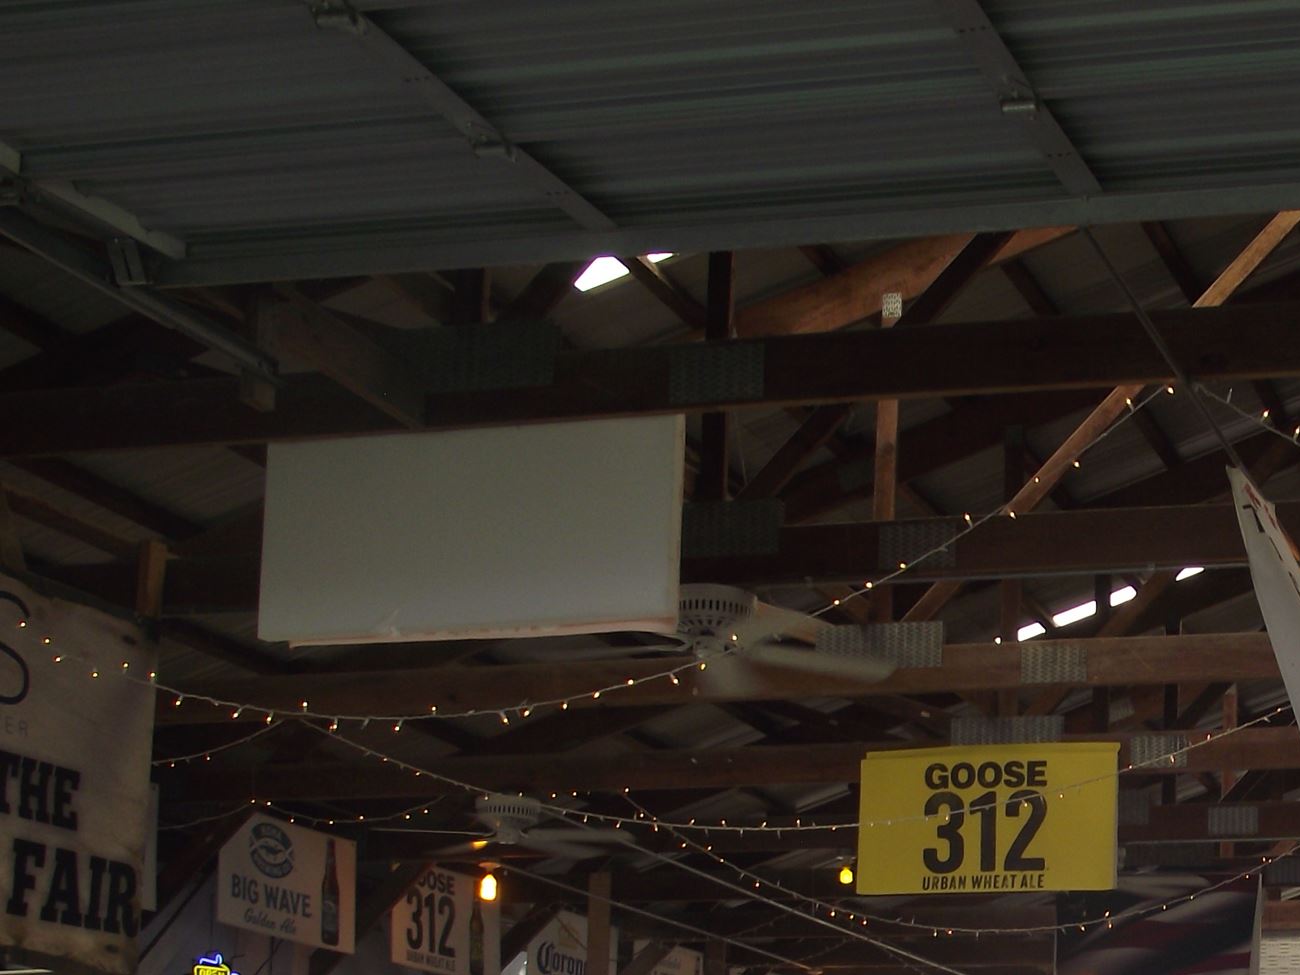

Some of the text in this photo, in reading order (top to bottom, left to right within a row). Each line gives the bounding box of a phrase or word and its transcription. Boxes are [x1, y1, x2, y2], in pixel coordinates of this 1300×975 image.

[0, 750, 80, 831] THE
[924, 760, 1048, 790] GOOSE
[923, 789, 1048, 874] 312
[6, 838, 140, 938] FAIR
[231, 873, 313, 918] BIG WAVE
[922, 874, 1045, 891] URBAN WHEAT ALE
[406, 888, 456, 957] 312
